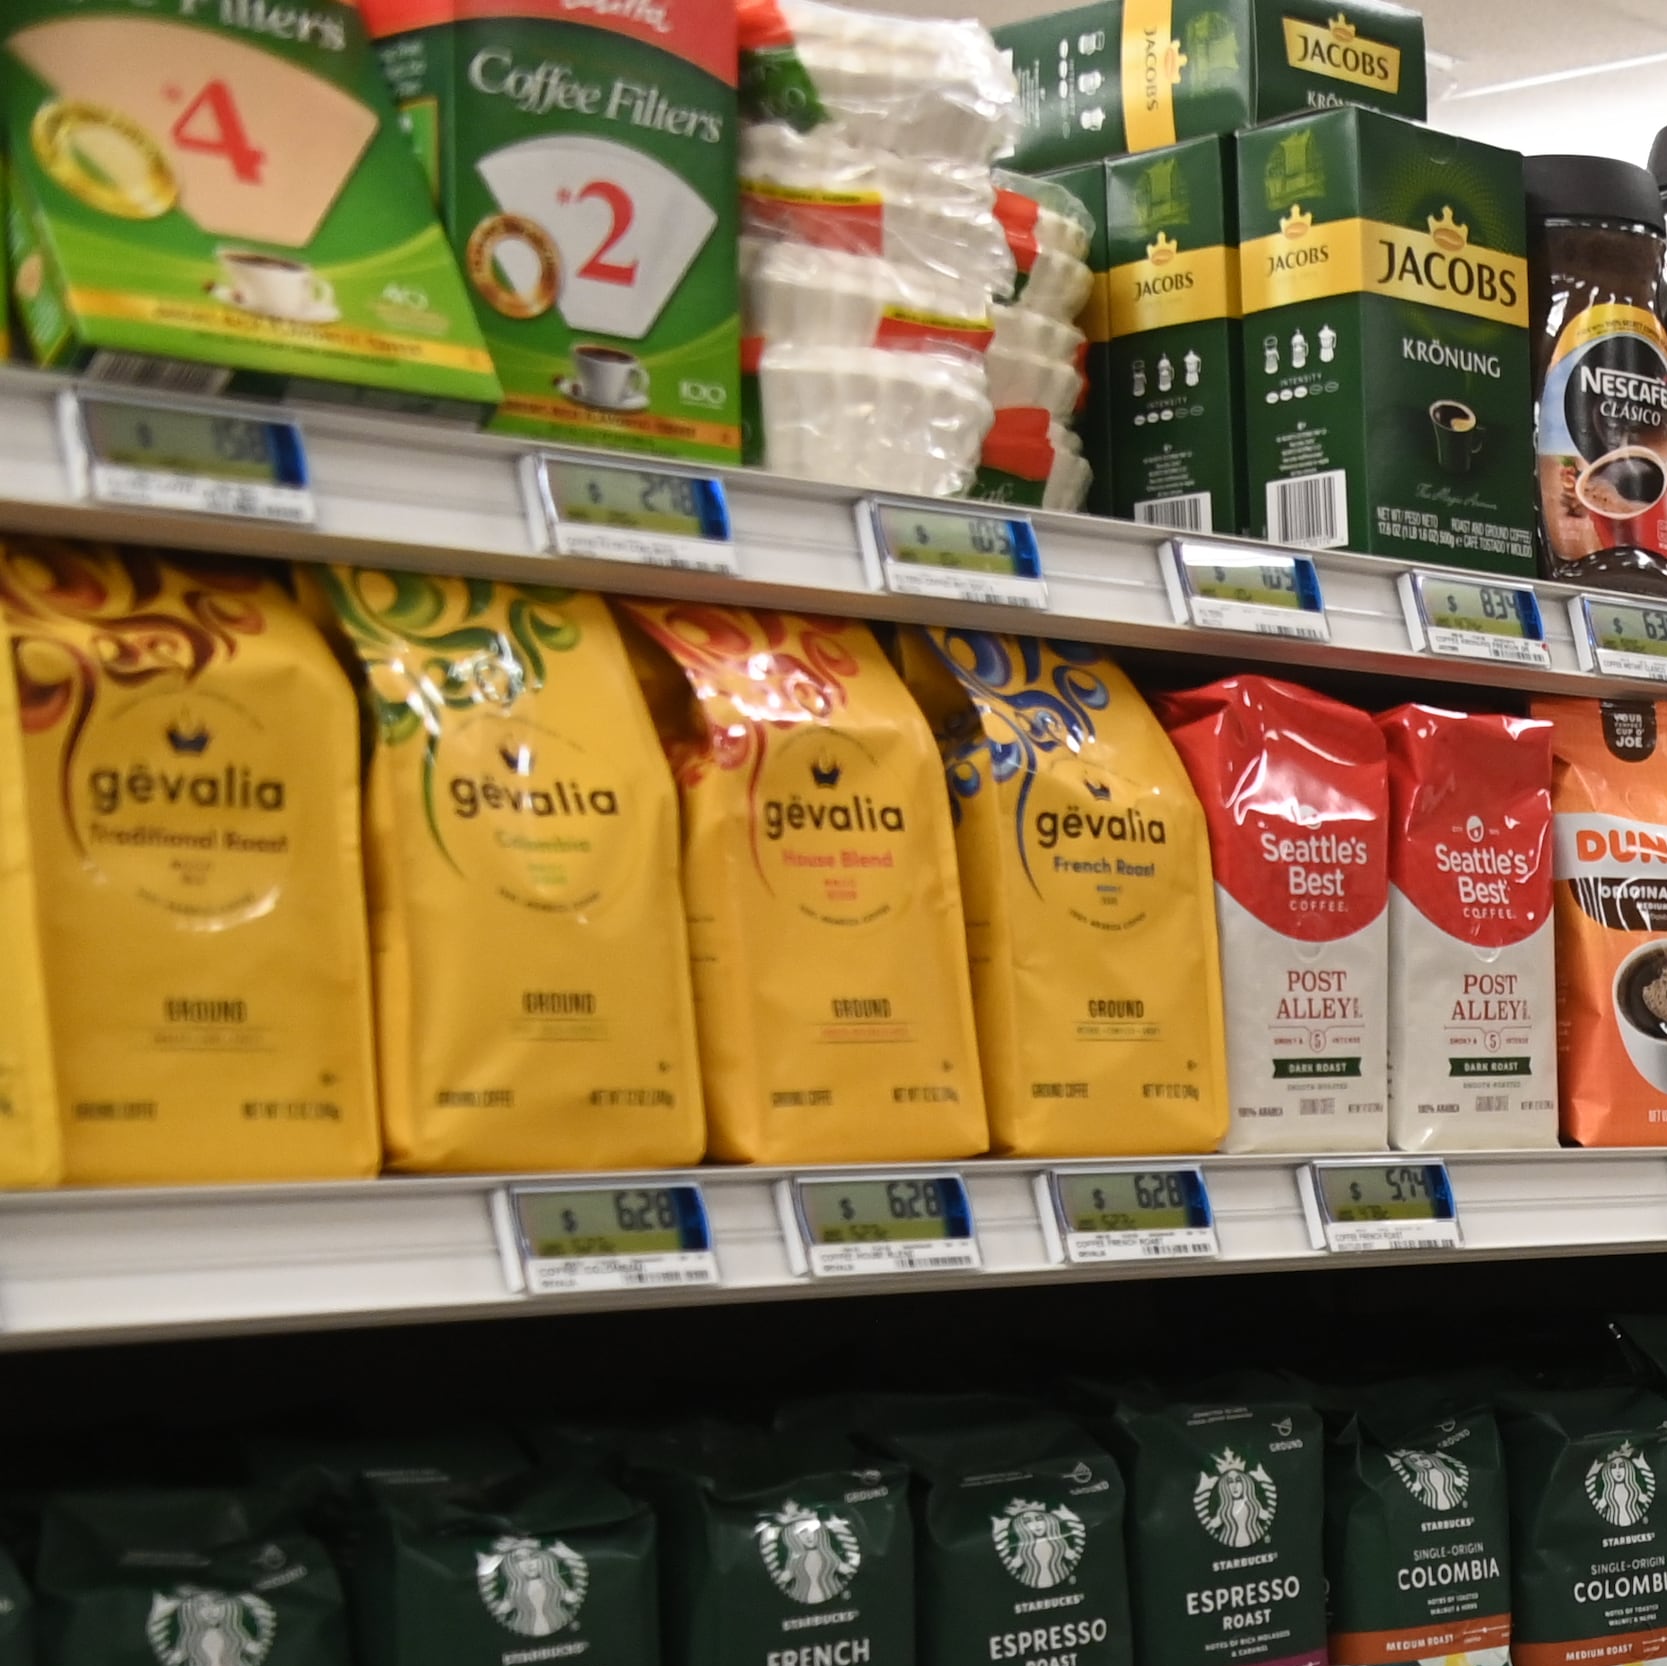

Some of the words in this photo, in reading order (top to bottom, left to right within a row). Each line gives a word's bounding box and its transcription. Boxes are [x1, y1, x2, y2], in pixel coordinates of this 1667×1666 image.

[1138, 25, 1161, 113] JACOBS
[1295, 32, 1390, 82] JACOBS
[466, 46, 603, 116] Coffee
[605, 60, 724, 144] Filters
[1266, 243, 1330, 275] JACOBS
[1376, 239, 1518, 308] JACOBS
[1133, 271, 1195, 300] JACOBS
[1401, 338, 1502, 378] KRÖNUNG
[1615, 733, 1644, 750] JOE
[1259, 832, 1369, 866] Seattle's
[1435, 842, 1530, 876] Seattle's
[1288, 863, 1345, 897] Best
[1458, 875, 1509, 905] Best
[1286, 970, 1347, 997] POST
[1462, 973, 1518, 996] POST
[1276, 997, 1352, 1021] ALLEY
[1451, 997, 1524, 1022] ALLEY
[1288, 1061, 1316, 1075] DARK
[1318, 1060, 1347, 1074] ROAST
[1463, 1060, 1490, 1073] DARK
[1492, 1059, 1517, 1073] ROAST
[1212, 1555, 1275, 1573] STARBUCKS
[1398, 1558, 1501, 1592] COLOMBIA
[1590, 1555, 1666, 1576] SINGLE-ORIGIN
[1185, 1576, 1301, 1617] ESPRESSO
[989, 1618, 1108, 1661] ESPRESSO
